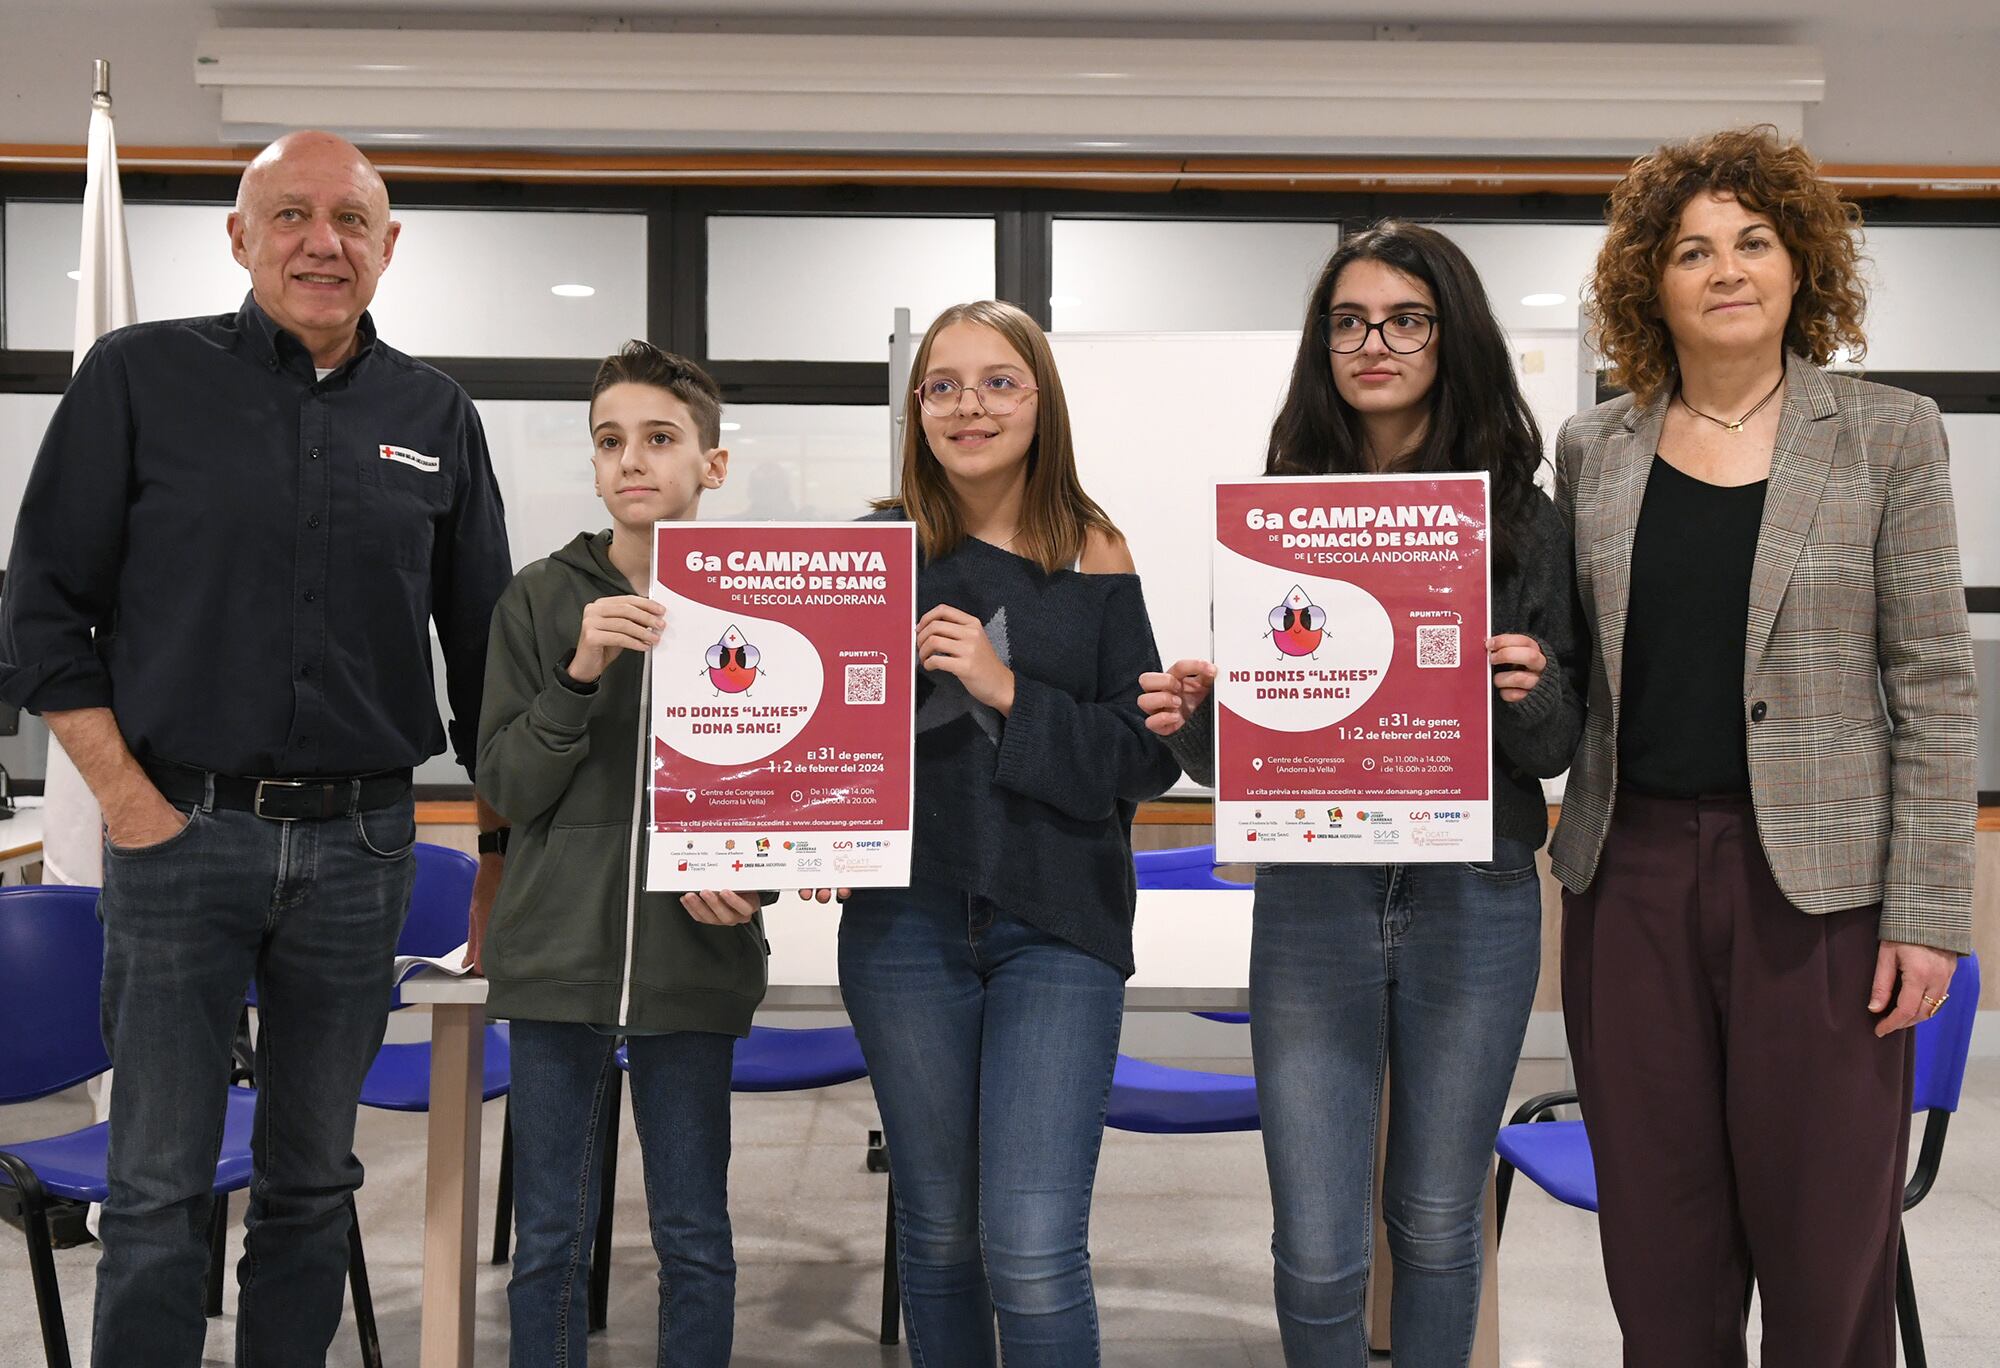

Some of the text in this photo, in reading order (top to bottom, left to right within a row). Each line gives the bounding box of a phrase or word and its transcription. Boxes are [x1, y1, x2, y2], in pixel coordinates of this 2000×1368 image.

[1246, 505, 1458, 530] 6a CAMPANYA
[1282, 530, 1372, 548] DONACIÓ
[1376, 533, 1401, 546] DE
[1404, 532, 1458, 546] SANG
[686, 551, 886, 572] 6a CAMPANYA
[1307, 552, 1369, 564] L'ESCOLA
[1372, 550, 1458, 563] ANDORRANA
[720, 574, 805, 590] DONACIÓ
[809, 576, 833, 589] DE
[835, 576, 886, 589] SANG
[743, 594, 802, 605] L'ESCOLA
[805, 594, 886, 605] ANDORRANA
[1229, 671, 1250, 682] NO
[1255, 671, 1305, 682] DONIS
[1256, 687, 1350, 699] DONA SANG!
[667, 707, 687, 717] NO
[691, 707, 739, 717] DONIS
[1379, 714, 1460, 729] El 31 de gener,
[692, 723, 781, 734] DONA SANG!
[1339, 727, 1460, 740] 1 i 2 de febrer del 2024
[819, 748, 835, 759] 31
[854, 753, 884, 761] gener,
[783, 761, 792, 773] 2
[809, 764, 839, 772] febrer
[841, 764, 856, 772] del
[858, 764, 884, 772] 2024
